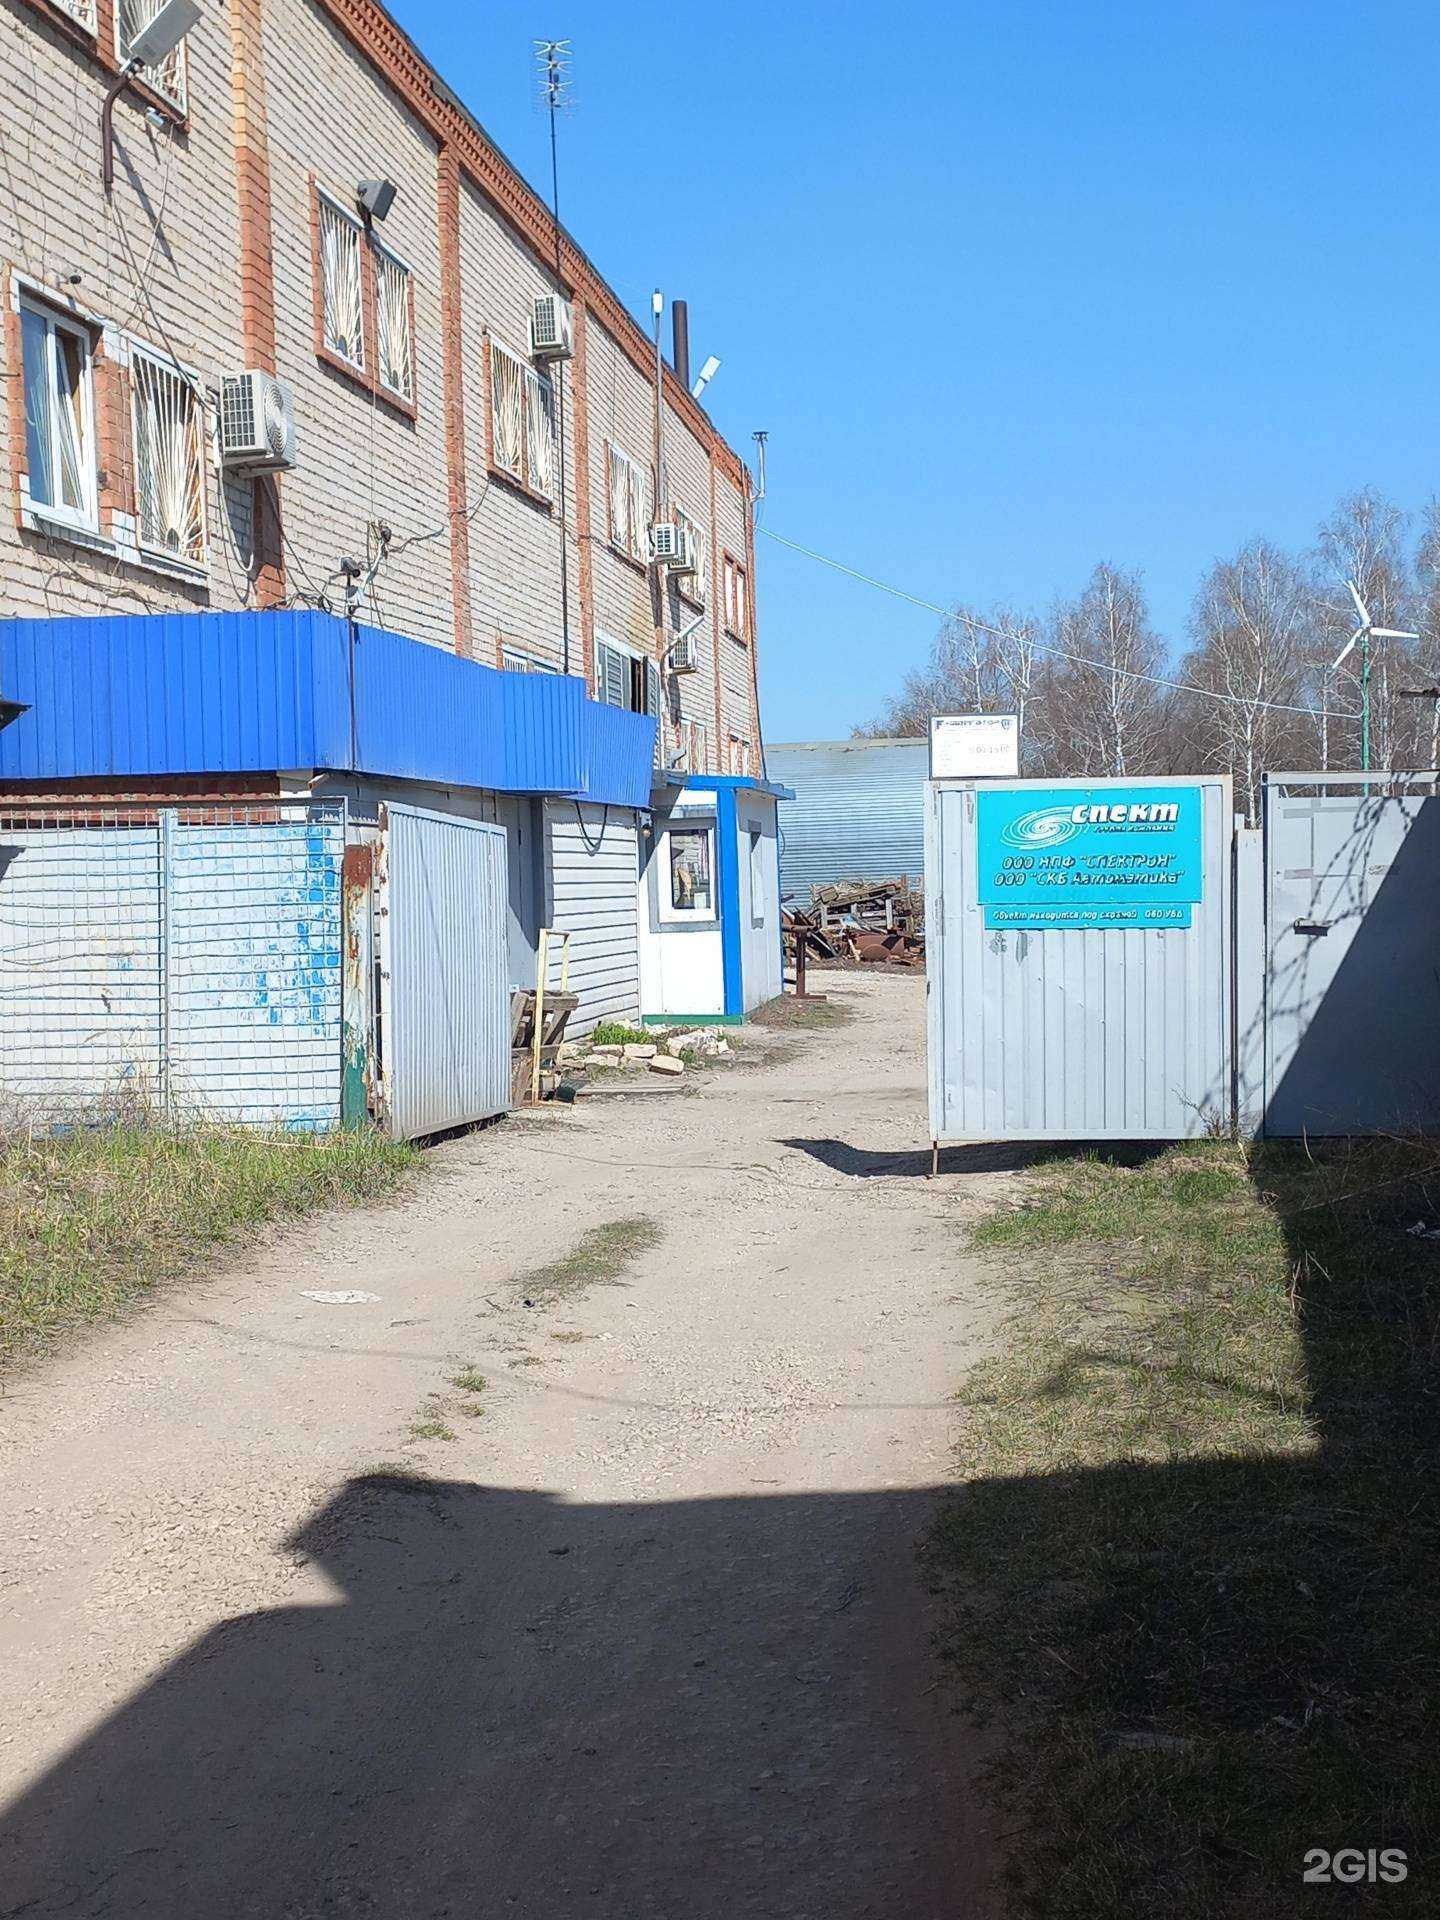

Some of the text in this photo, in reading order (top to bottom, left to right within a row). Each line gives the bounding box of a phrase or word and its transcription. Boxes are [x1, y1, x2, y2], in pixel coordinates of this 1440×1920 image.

[1002, 856, 1035, 870] ООО
[1038, 855, 1076, 869] НПФ
[994, 872, 1026, 886] ООО
